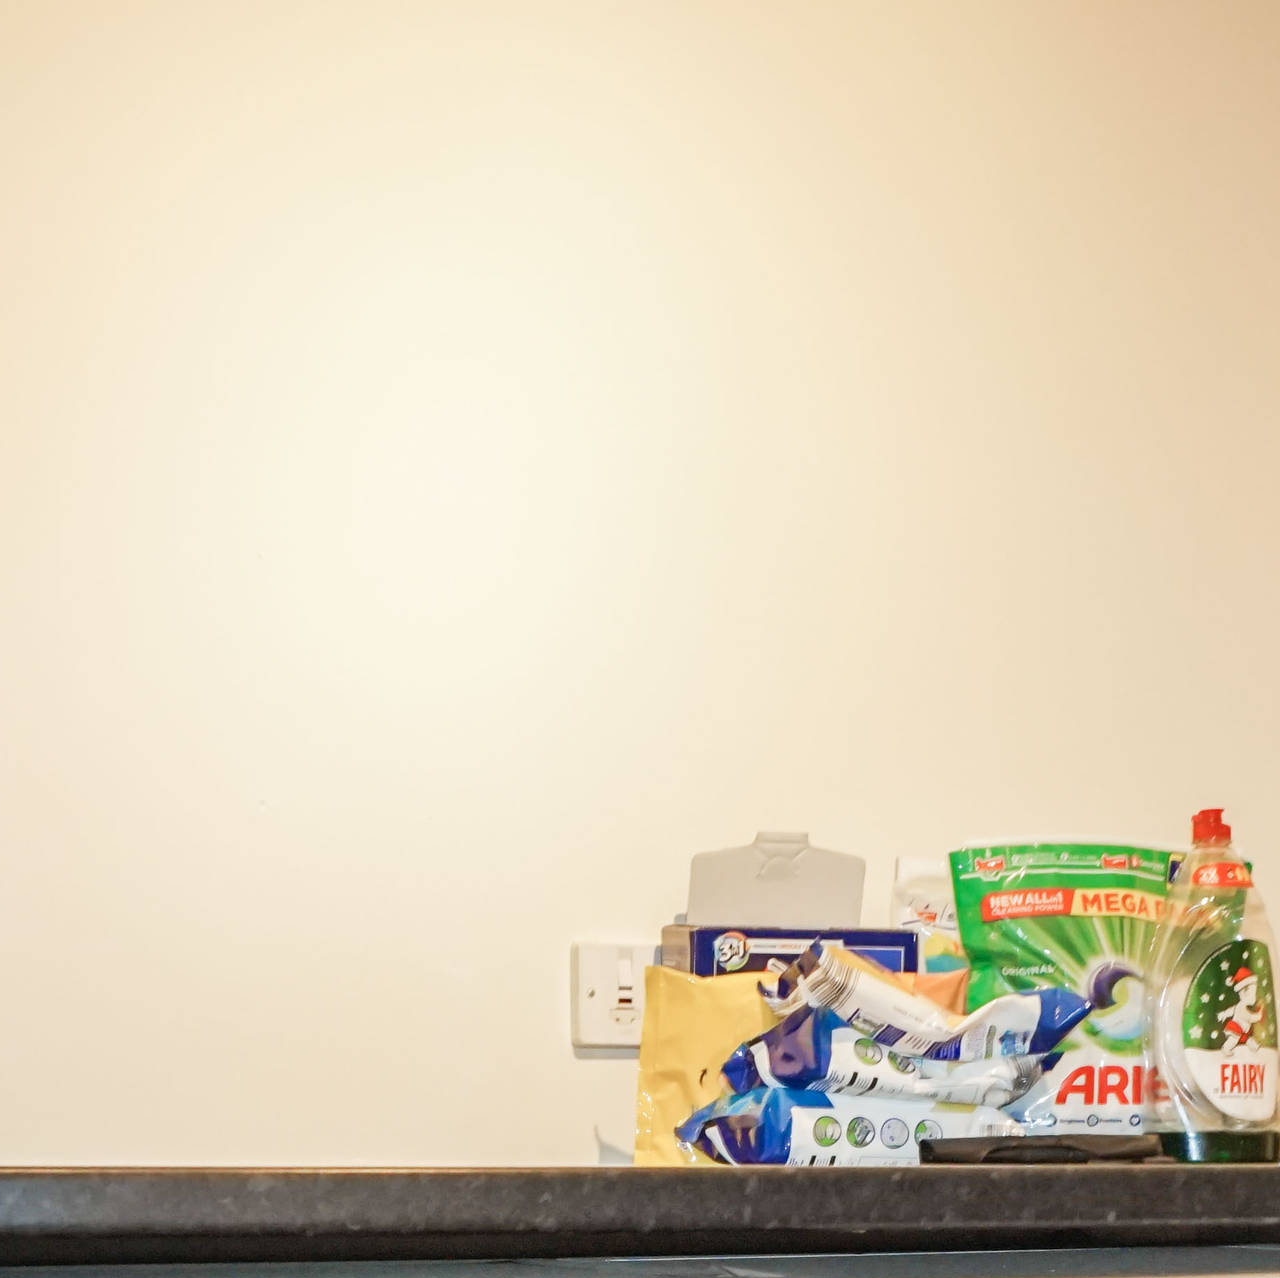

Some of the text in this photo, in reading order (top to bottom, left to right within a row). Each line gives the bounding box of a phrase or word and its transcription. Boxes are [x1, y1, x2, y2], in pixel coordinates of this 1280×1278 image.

[989, 893, 1024, 909] NEW
[1081, 893, 1150, 917] MEGA
[1055, 1065, 1172, 1105] ARIE
[1221, 1063, 1265, 1094] FAIRY
